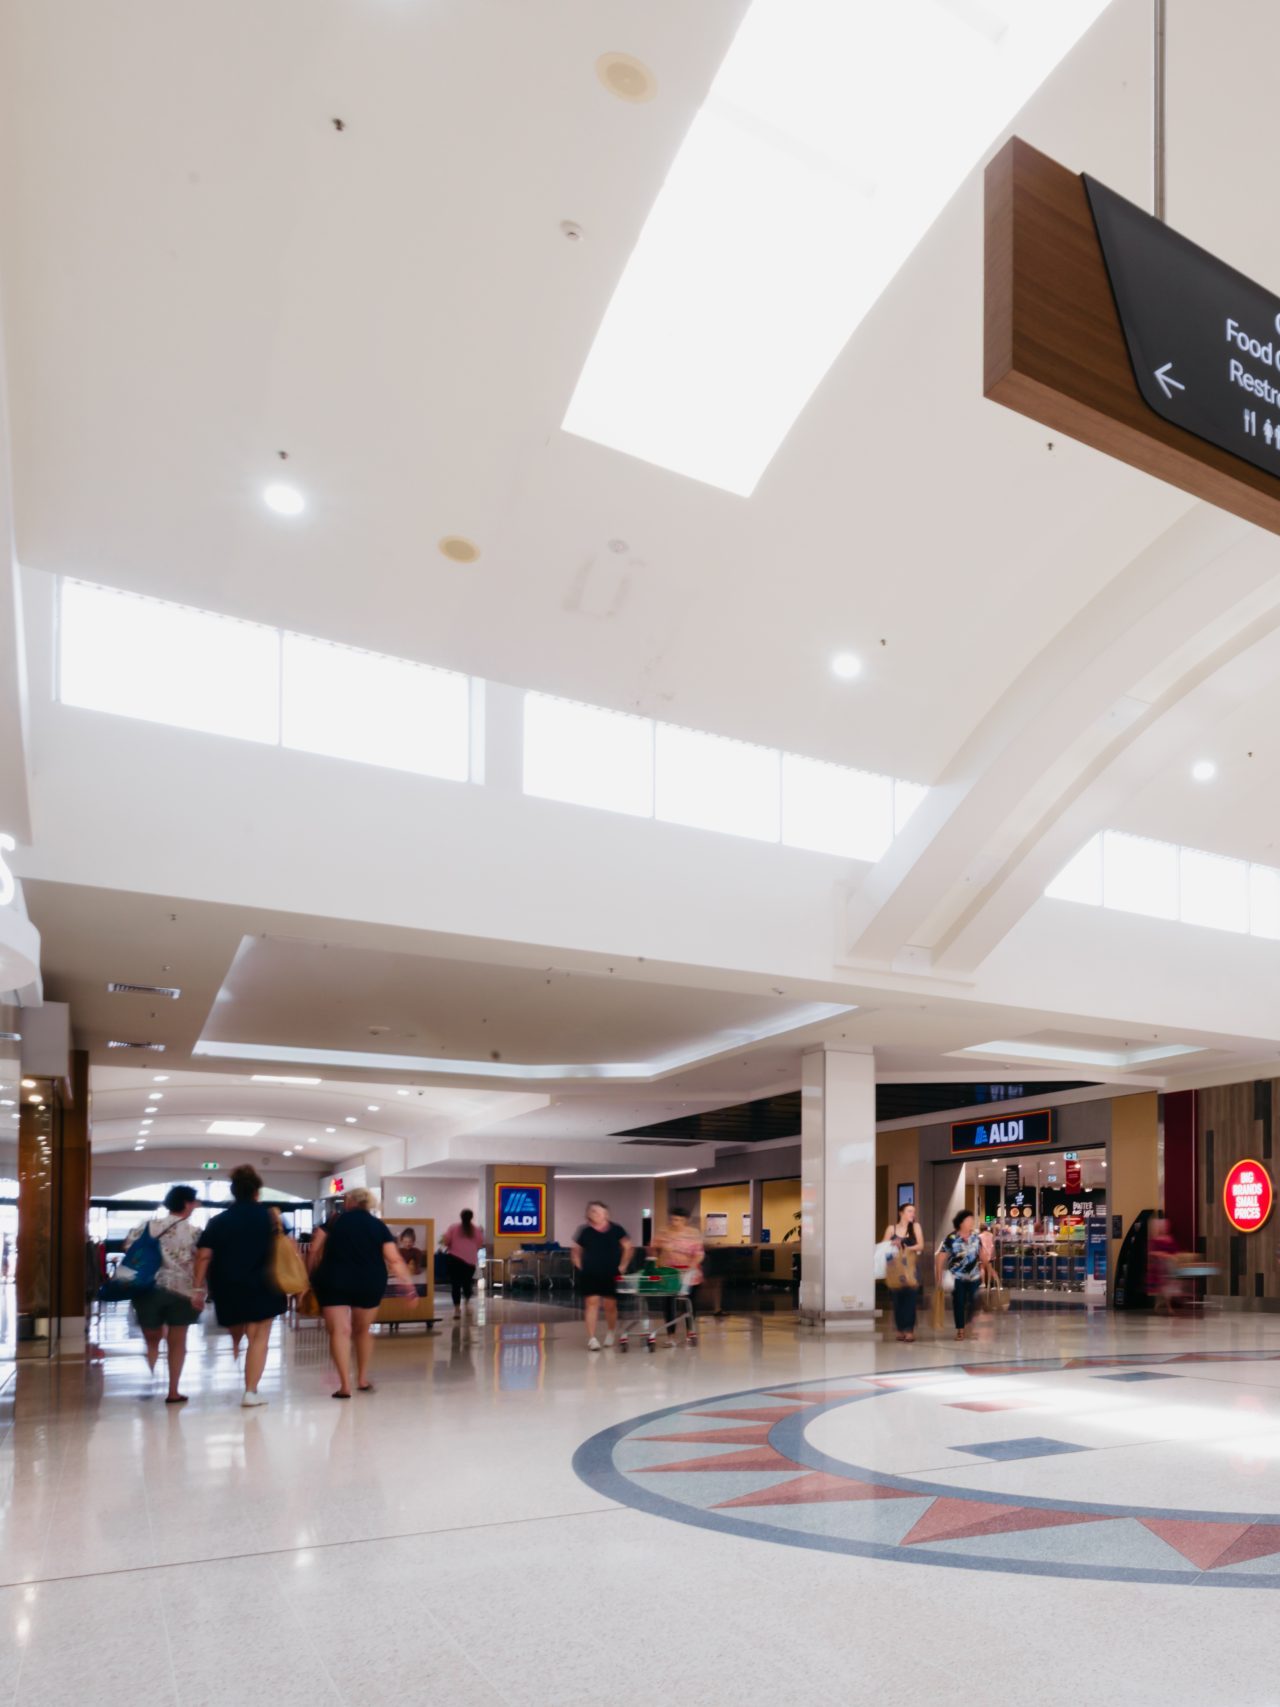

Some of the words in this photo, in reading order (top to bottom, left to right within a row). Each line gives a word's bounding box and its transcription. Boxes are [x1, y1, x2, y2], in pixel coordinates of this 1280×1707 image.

[1226, 318, 1273, 365] Food
[989, 1119, 1024, 1144] ALDI
[1240, 1171, 1254, 1183] BIG
[1232, 1183, 1263, 1196] BRANDS
[1235, 1195, 1259, 1207] SMALL
[1234, 1207, 1261, 1219] PRICES
[503, 1215, 538, 1226] ALDI
